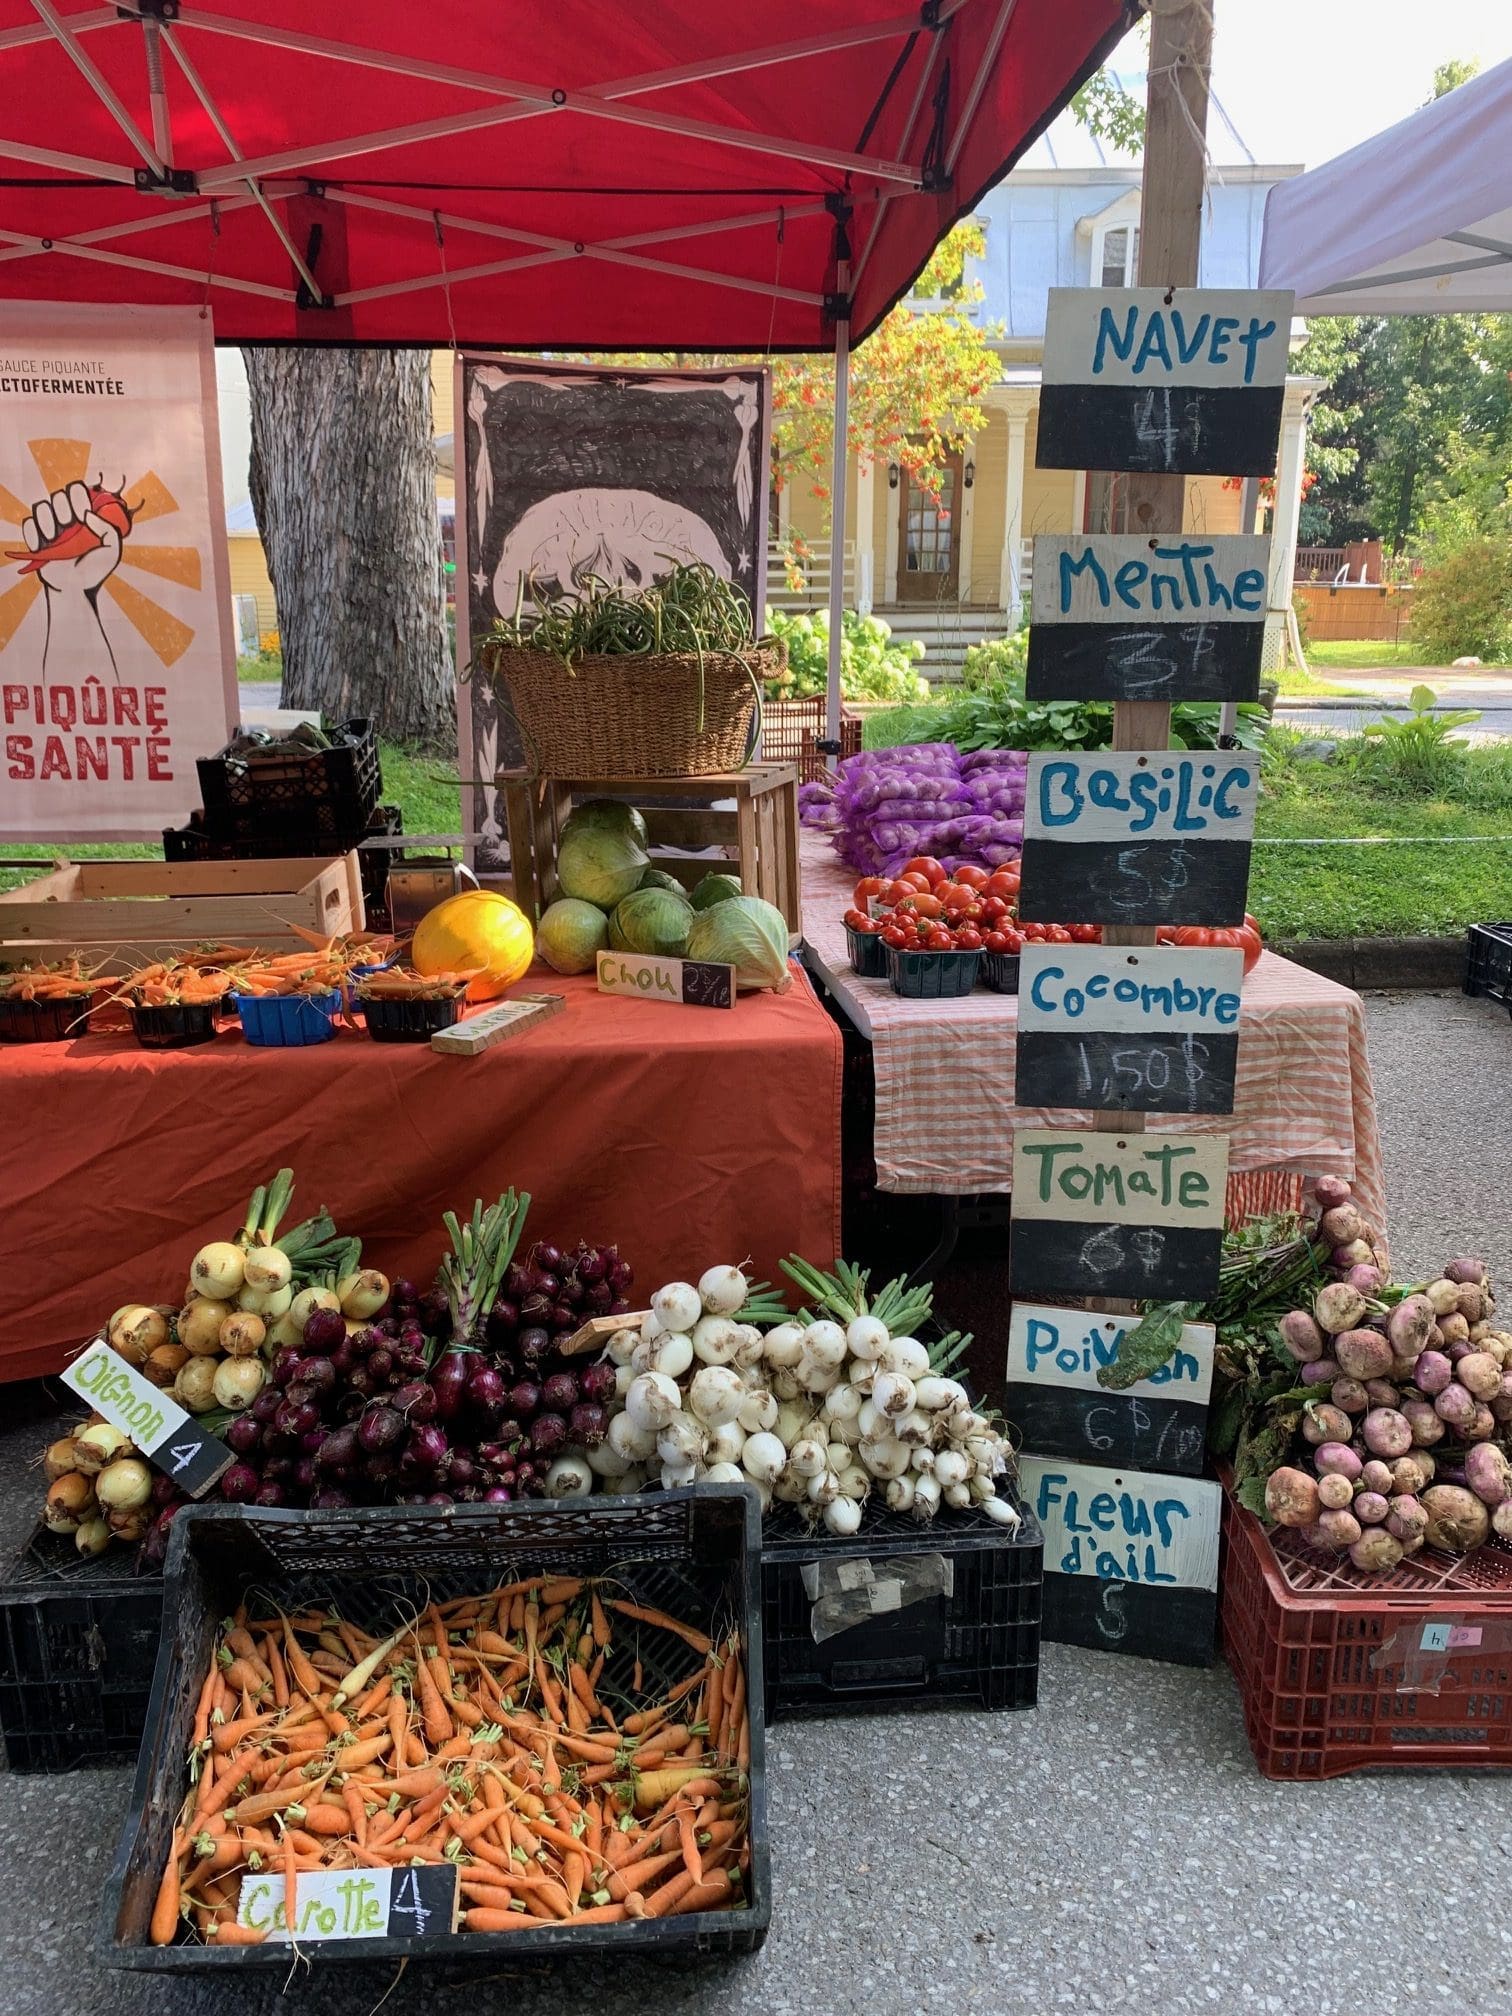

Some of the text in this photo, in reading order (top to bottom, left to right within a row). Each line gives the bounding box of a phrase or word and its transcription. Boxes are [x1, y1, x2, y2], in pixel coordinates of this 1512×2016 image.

[42, 361, 105, 375] PIQUANTE
[2, 675, 169, 732] PIQÛRE
[6, 725, 174, 781] SANTÉ
[600, 959, 677, 996] Chou
[1031, 966, 1241, 1024] Cocombre
[170, 1441, 204, 1474] 4
[1095, 1582, 1128, 1639] 5
[391, 1868, 432, 1934] 4
